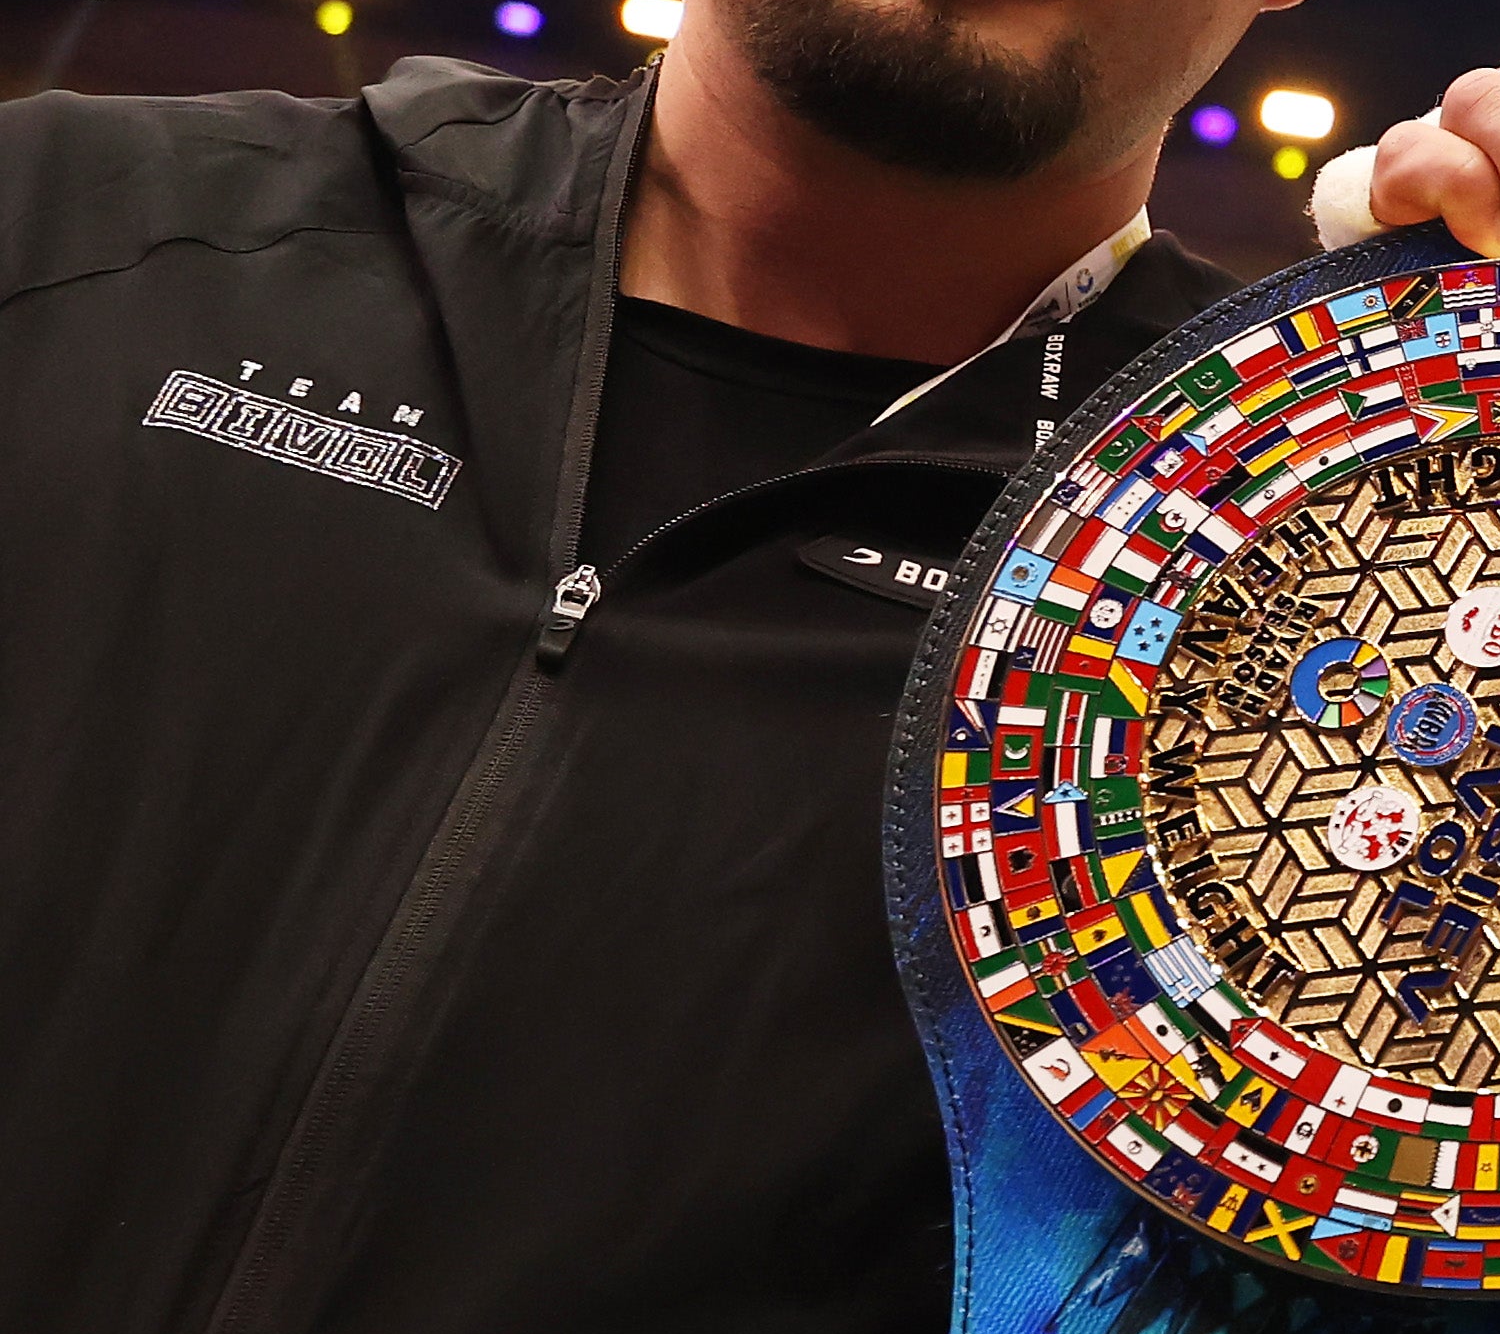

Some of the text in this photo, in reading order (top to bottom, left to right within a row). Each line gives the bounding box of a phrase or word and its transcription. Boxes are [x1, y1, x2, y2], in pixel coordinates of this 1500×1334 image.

[240, 360, 424, 427] TEAM
[1040, 334, 1065, 401] BOXRAW
[142, 370, 463, 511] BIVOL
